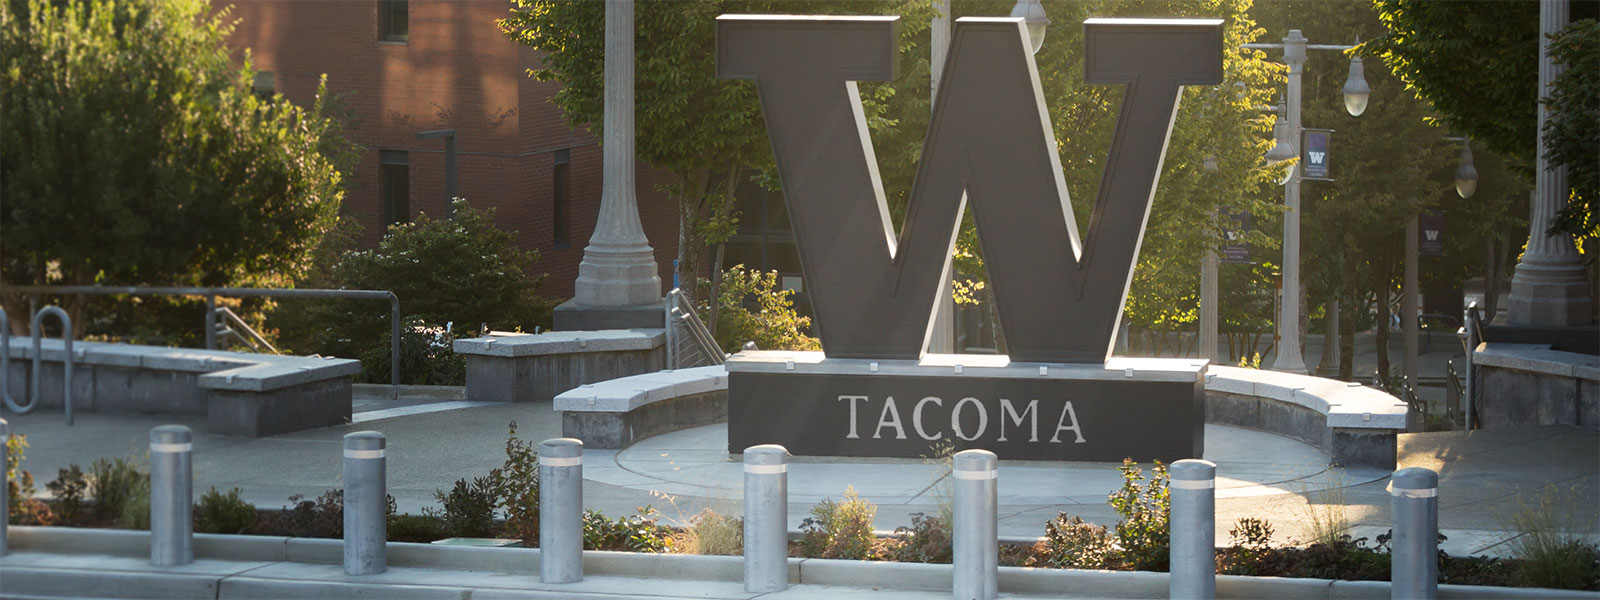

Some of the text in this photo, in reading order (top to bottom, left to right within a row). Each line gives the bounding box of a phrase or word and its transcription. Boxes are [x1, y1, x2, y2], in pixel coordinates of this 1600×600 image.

[1309, 151, 1325, 164] W
[715, 14, 1224, 363] W
[1425, 230, 1439, 241] W
[838, 395, 1086, 443] TACOMA
